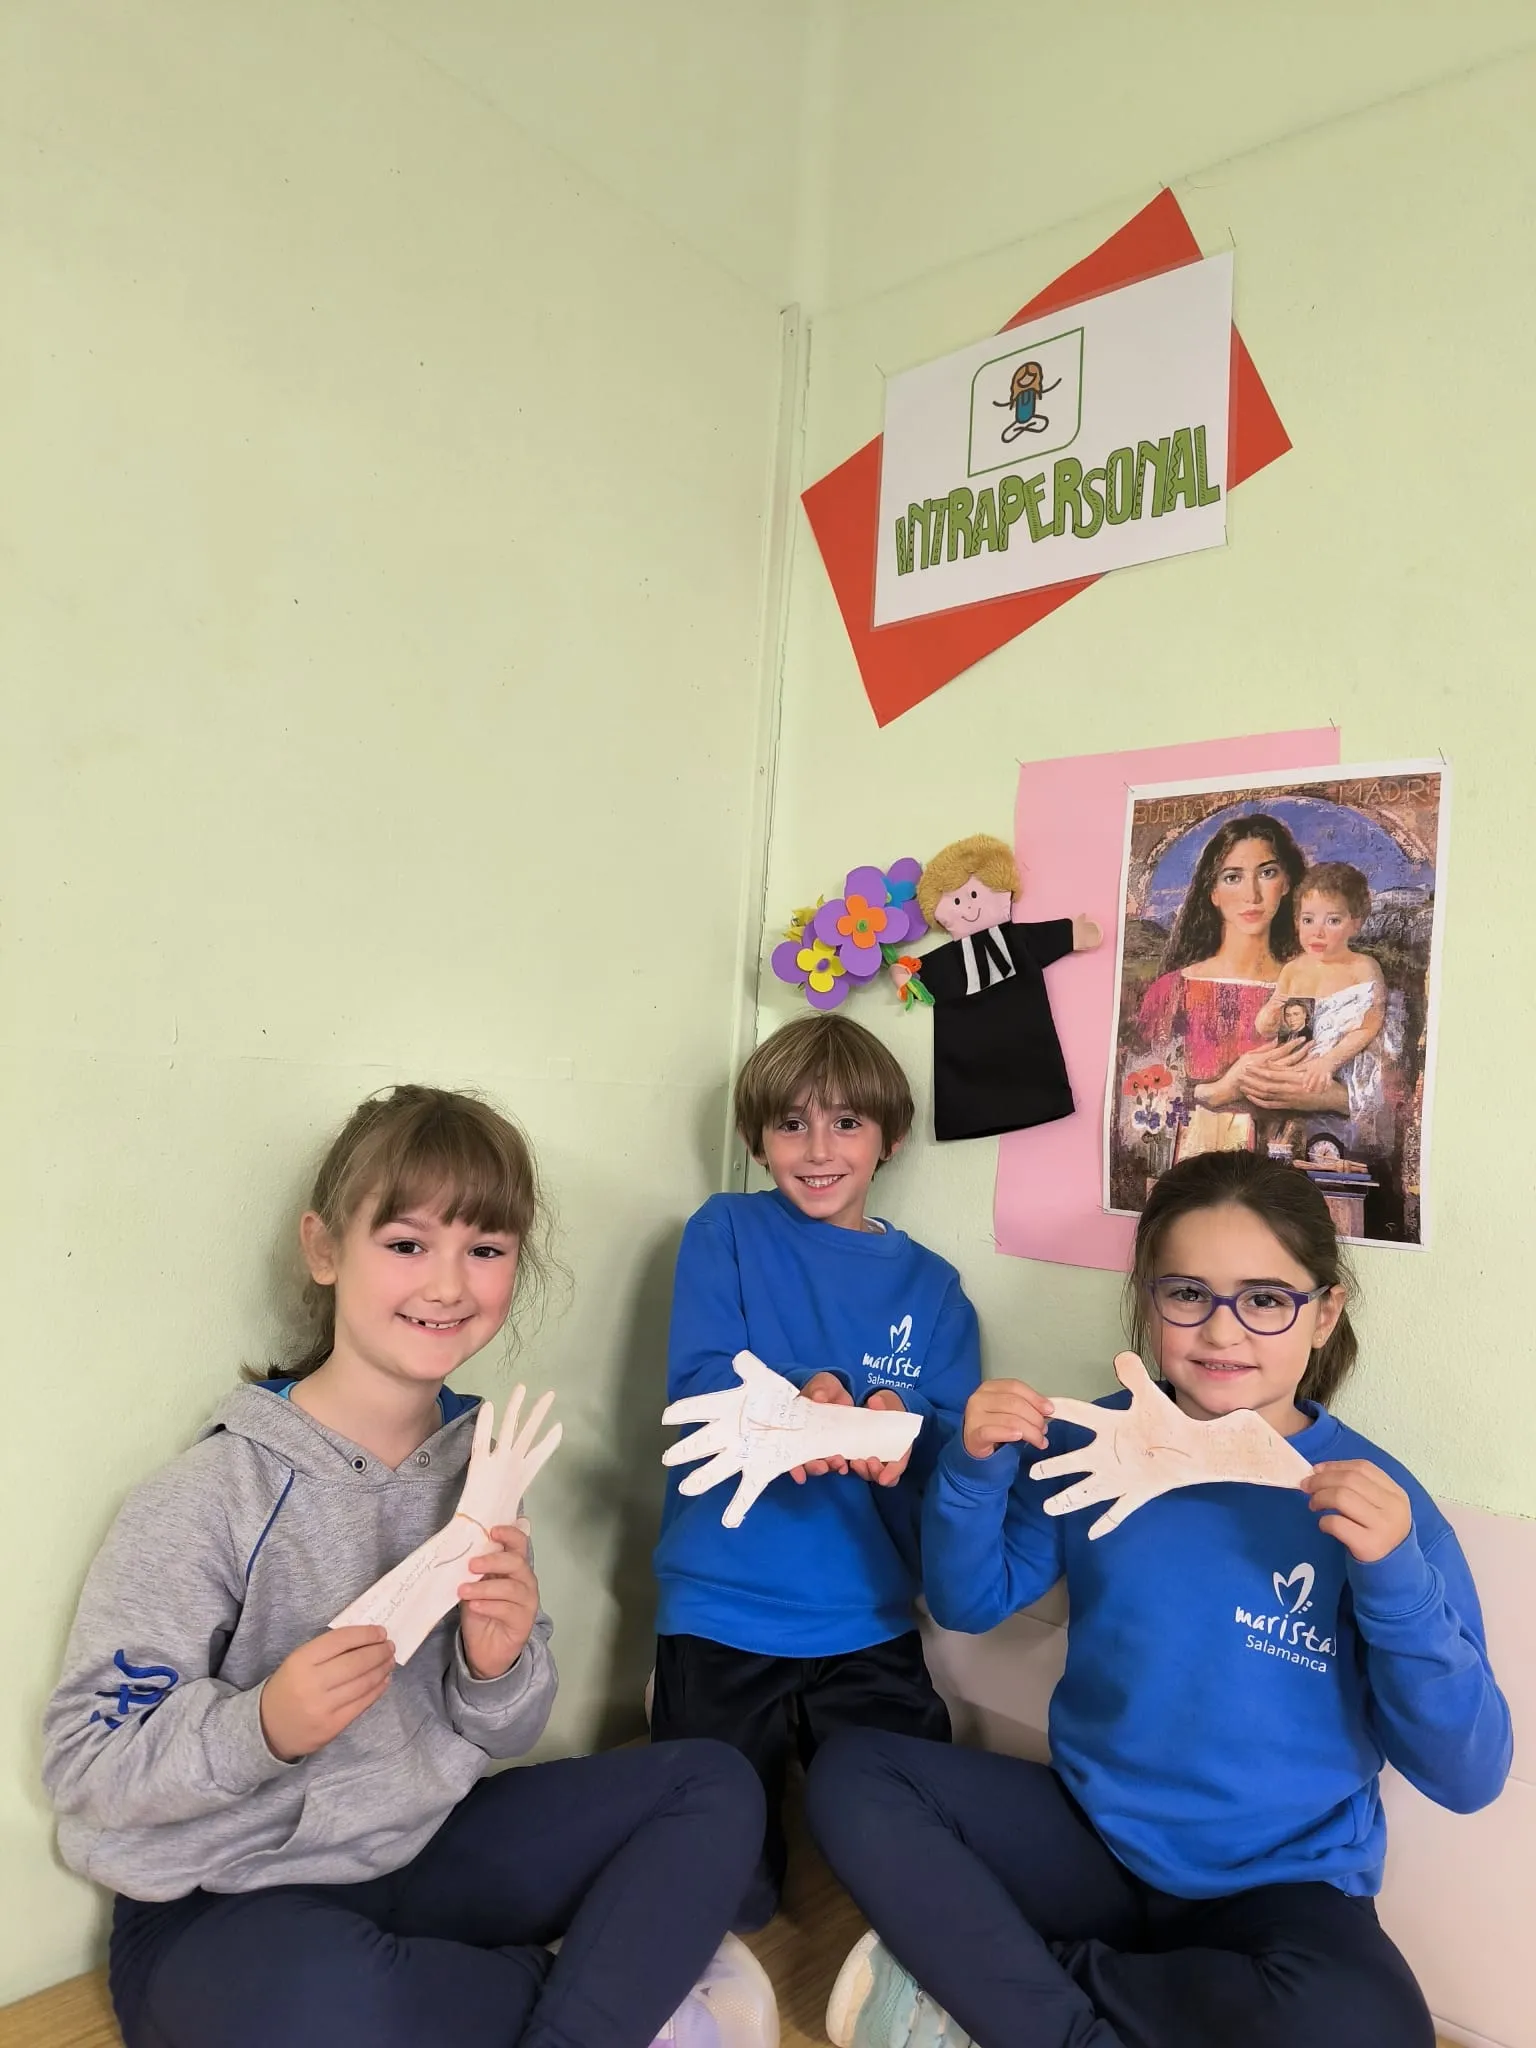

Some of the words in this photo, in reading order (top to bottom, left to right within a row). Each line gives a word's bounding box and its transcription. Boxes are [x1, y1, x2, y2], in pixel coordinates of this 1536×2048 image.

[895, 425, 1221, 576] INTRAPERSONAL
[1135, 799, 1208, 825] BUENA
[867, 1372, 915, 1392] Salamanc
[1245, 1634, 1328, 1673] Salamanca
